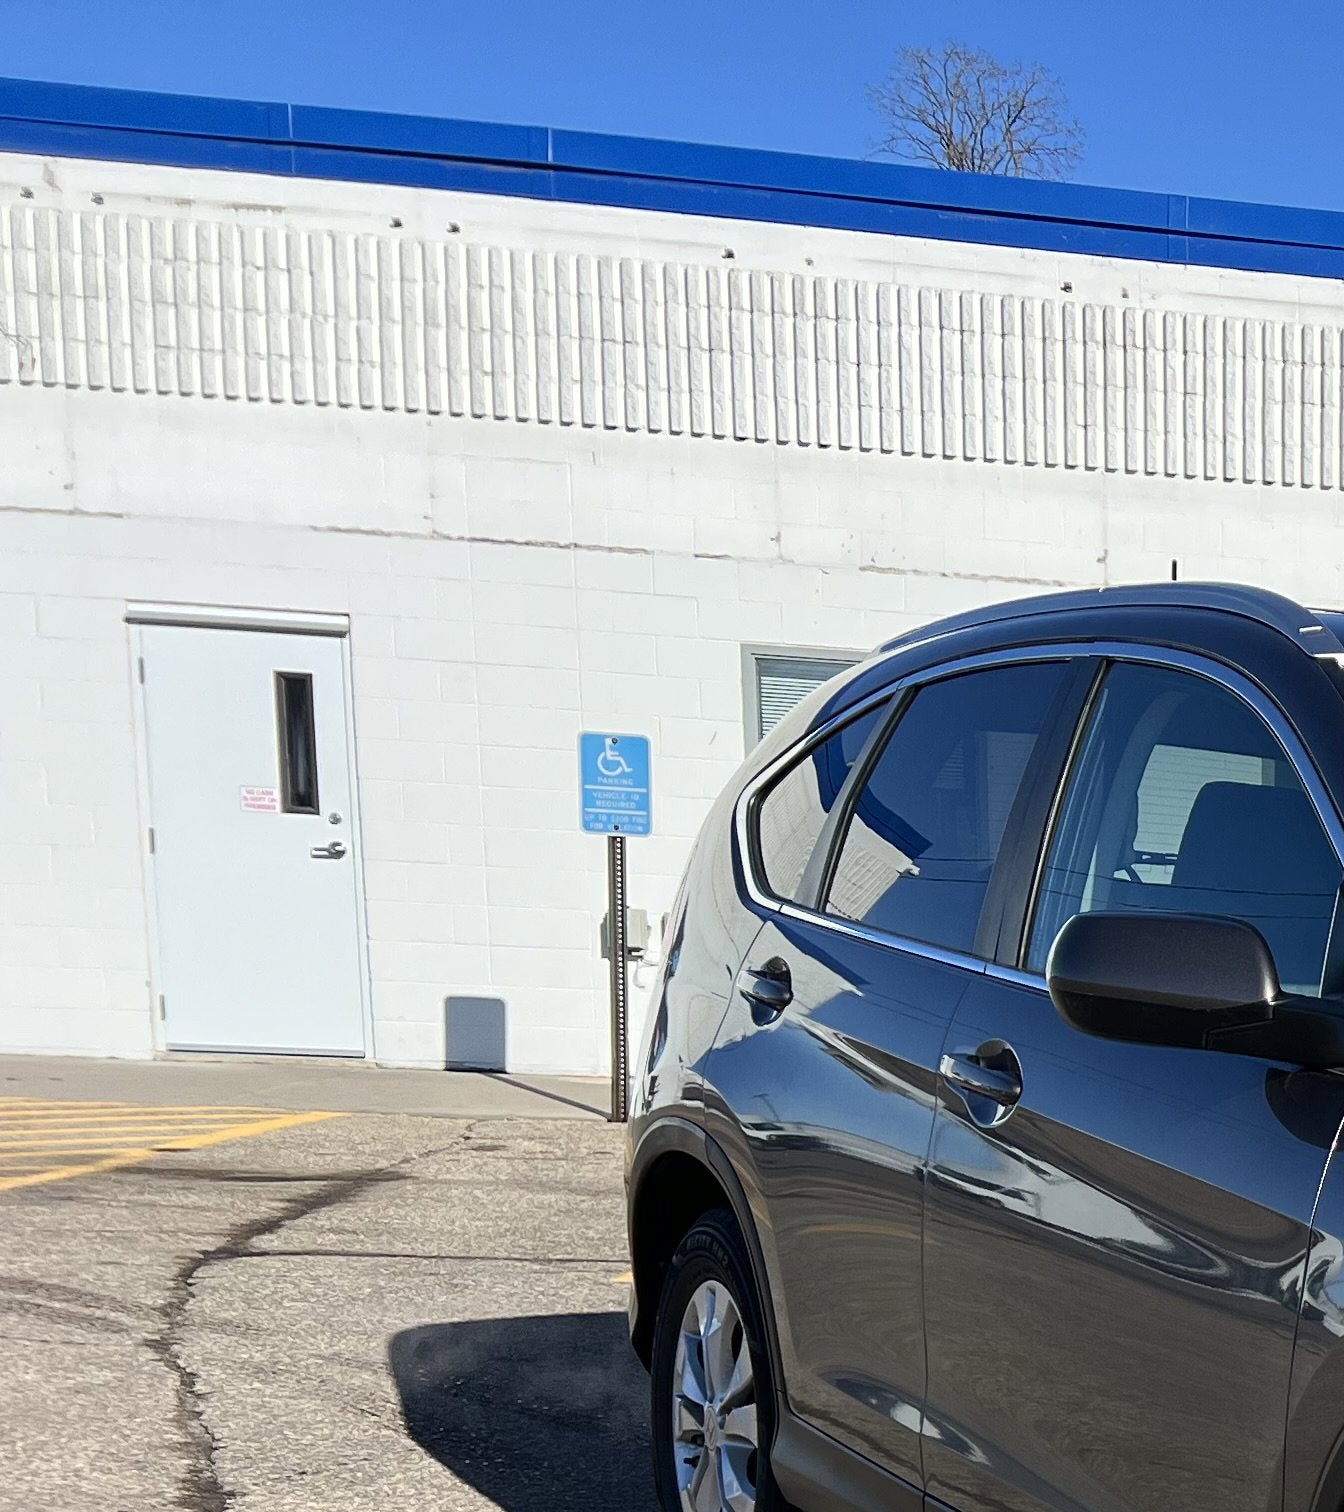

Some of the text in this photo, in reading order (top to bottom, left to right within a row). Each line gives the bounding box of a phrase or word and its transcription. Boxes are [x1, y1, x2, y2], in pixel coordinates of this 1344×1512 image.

[598, 777, 633, 786] PARKING
[592, 791, 626, 800] VEHICLE
[596, 800, 636, 809] REQUIRED
